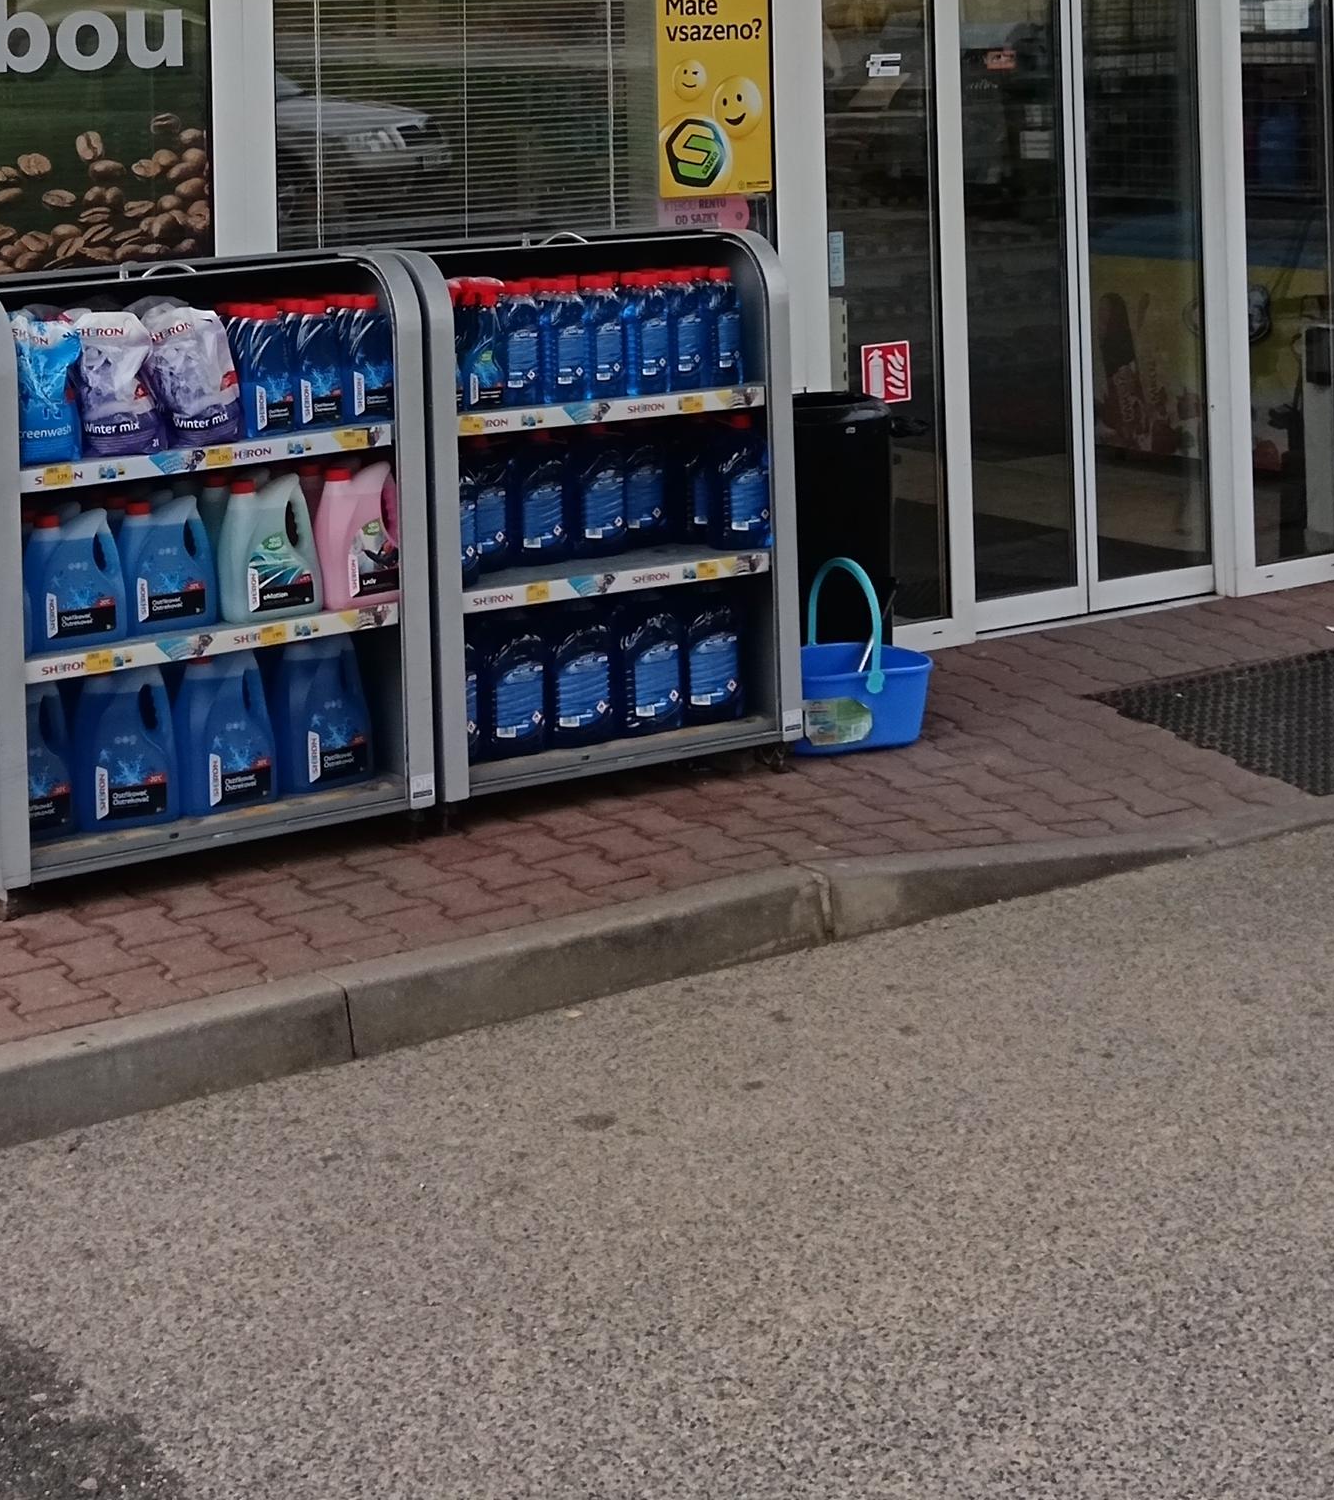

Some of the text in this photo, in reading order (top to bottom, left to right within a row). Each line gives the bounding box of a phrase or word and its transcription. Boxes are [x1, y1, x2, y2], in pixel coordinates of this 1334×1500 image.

[665, 18, 763, 41] vsazeno?
[212, 411, 229, 425] mix
[120, 419, 140, 432] mix
